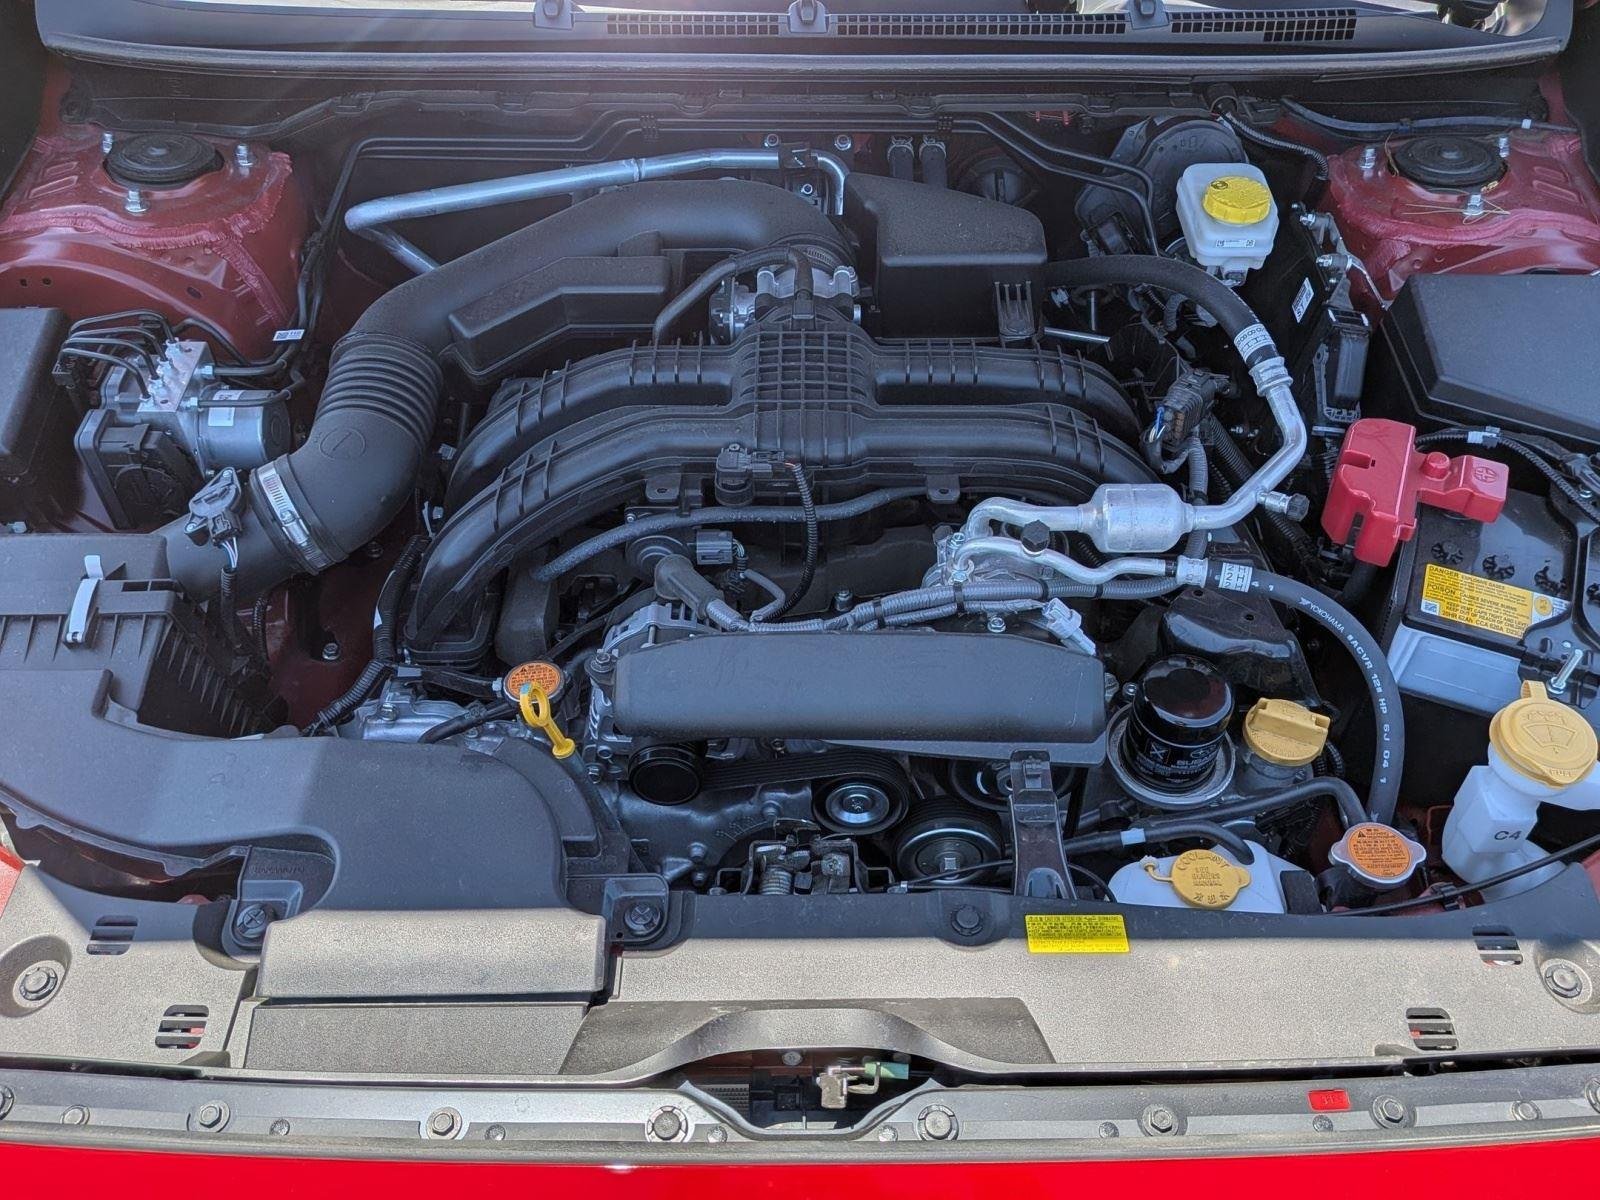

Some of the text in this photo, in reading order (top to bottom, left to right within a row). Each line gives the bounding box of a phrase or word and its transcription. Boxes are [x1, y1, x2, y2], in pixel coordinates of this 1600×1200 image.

[1429, 565, 1459, 577] DANGER
[1426, 582, 1455, 595] POISON
[1310, 602, 1345, 633] YOKOHAMA
[1379, 698, 1387, 714] HP
[1494, 830, 1521, 841] C4
